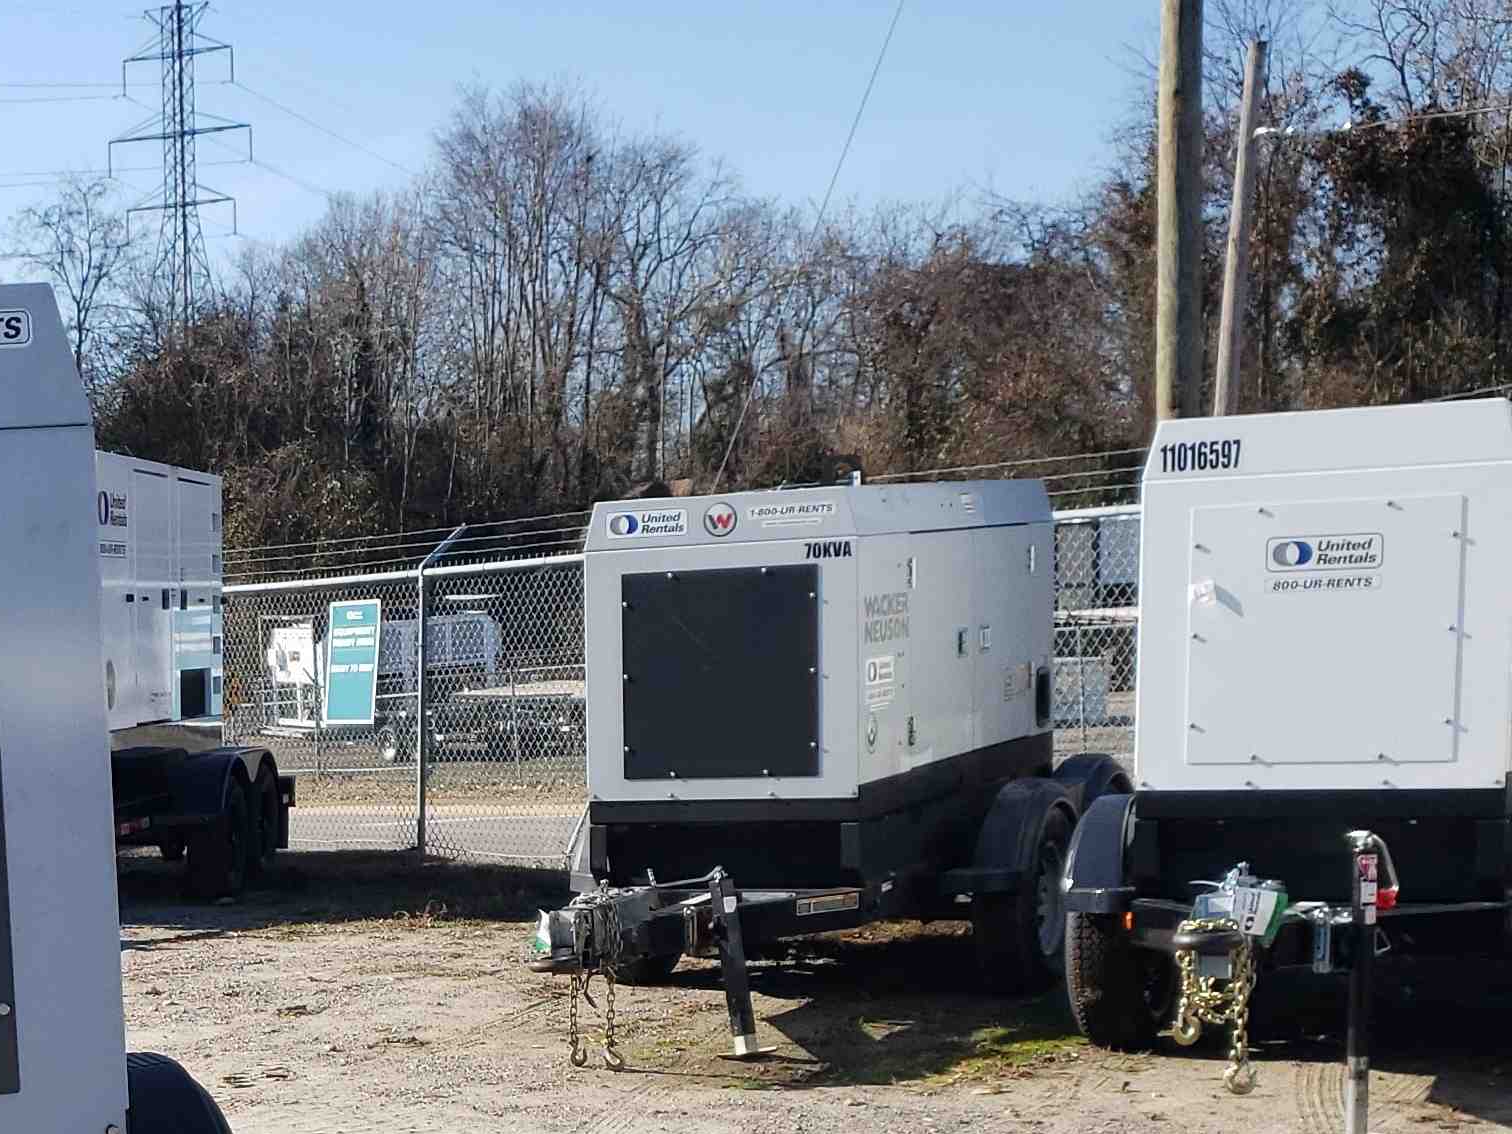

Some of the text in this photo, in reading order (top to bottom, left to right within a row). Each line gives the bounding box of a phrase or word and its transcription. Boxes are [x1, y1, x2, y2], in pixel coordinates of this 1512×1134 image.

[1160, 439, 1241, 473] 11016597
[641, 511, 682, 523] United
[641, 523, 685, 534] Rentals
[804, 541, 852, 559] 70KVA
[1317, 537, 1374, 552] United
[1316, 551, 1377, 565] Rentals
[1272, 576, 1374, 591] 800-UR-RENTS
[864, 593, 909, 617] WACKER
[864, 616, 910, 643] NEUSON
